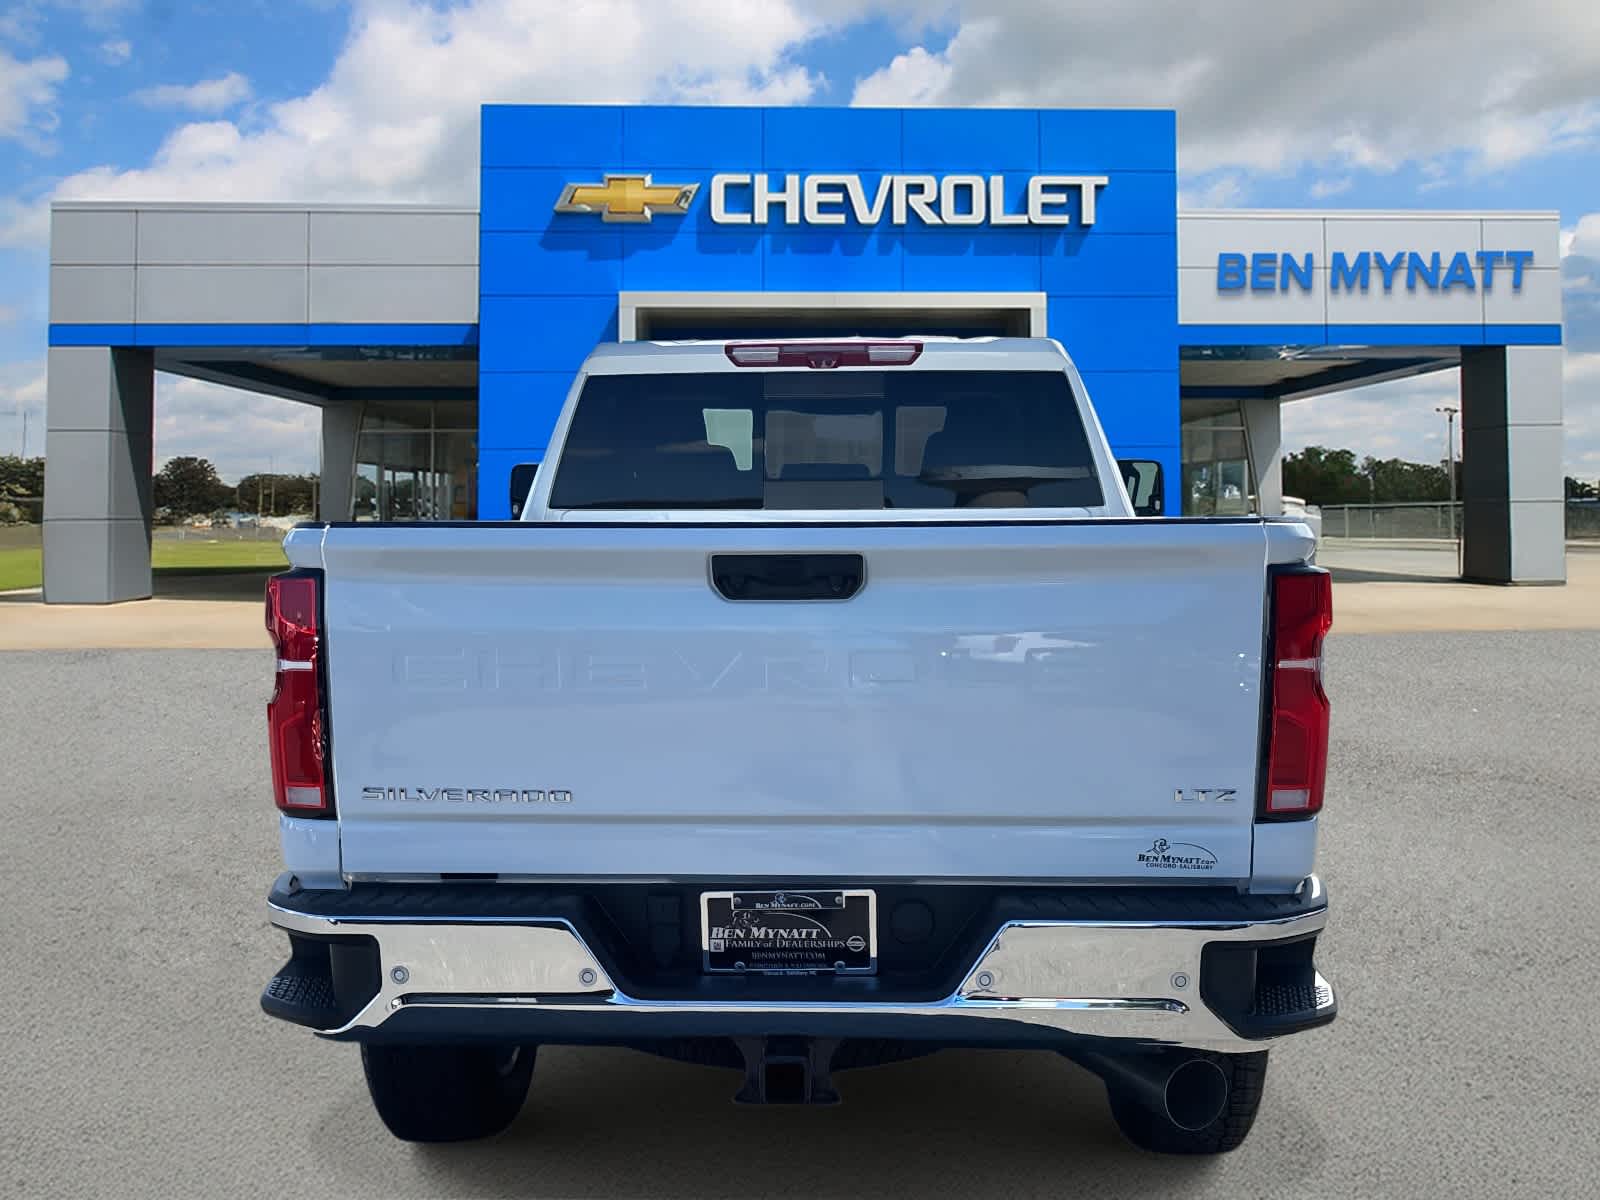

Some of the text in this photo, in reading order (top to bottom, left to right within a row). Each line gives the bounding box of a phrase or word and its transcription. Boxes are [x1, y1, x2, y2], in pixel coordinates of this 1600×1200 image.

[710, 173, 1109, 225] CHEVROLET
[1217, 250, 1534, 294] BEN MYNATT
[362, 786, 572, 804] SILVERADO
[1174, 788, 1237, 802] LTZ
